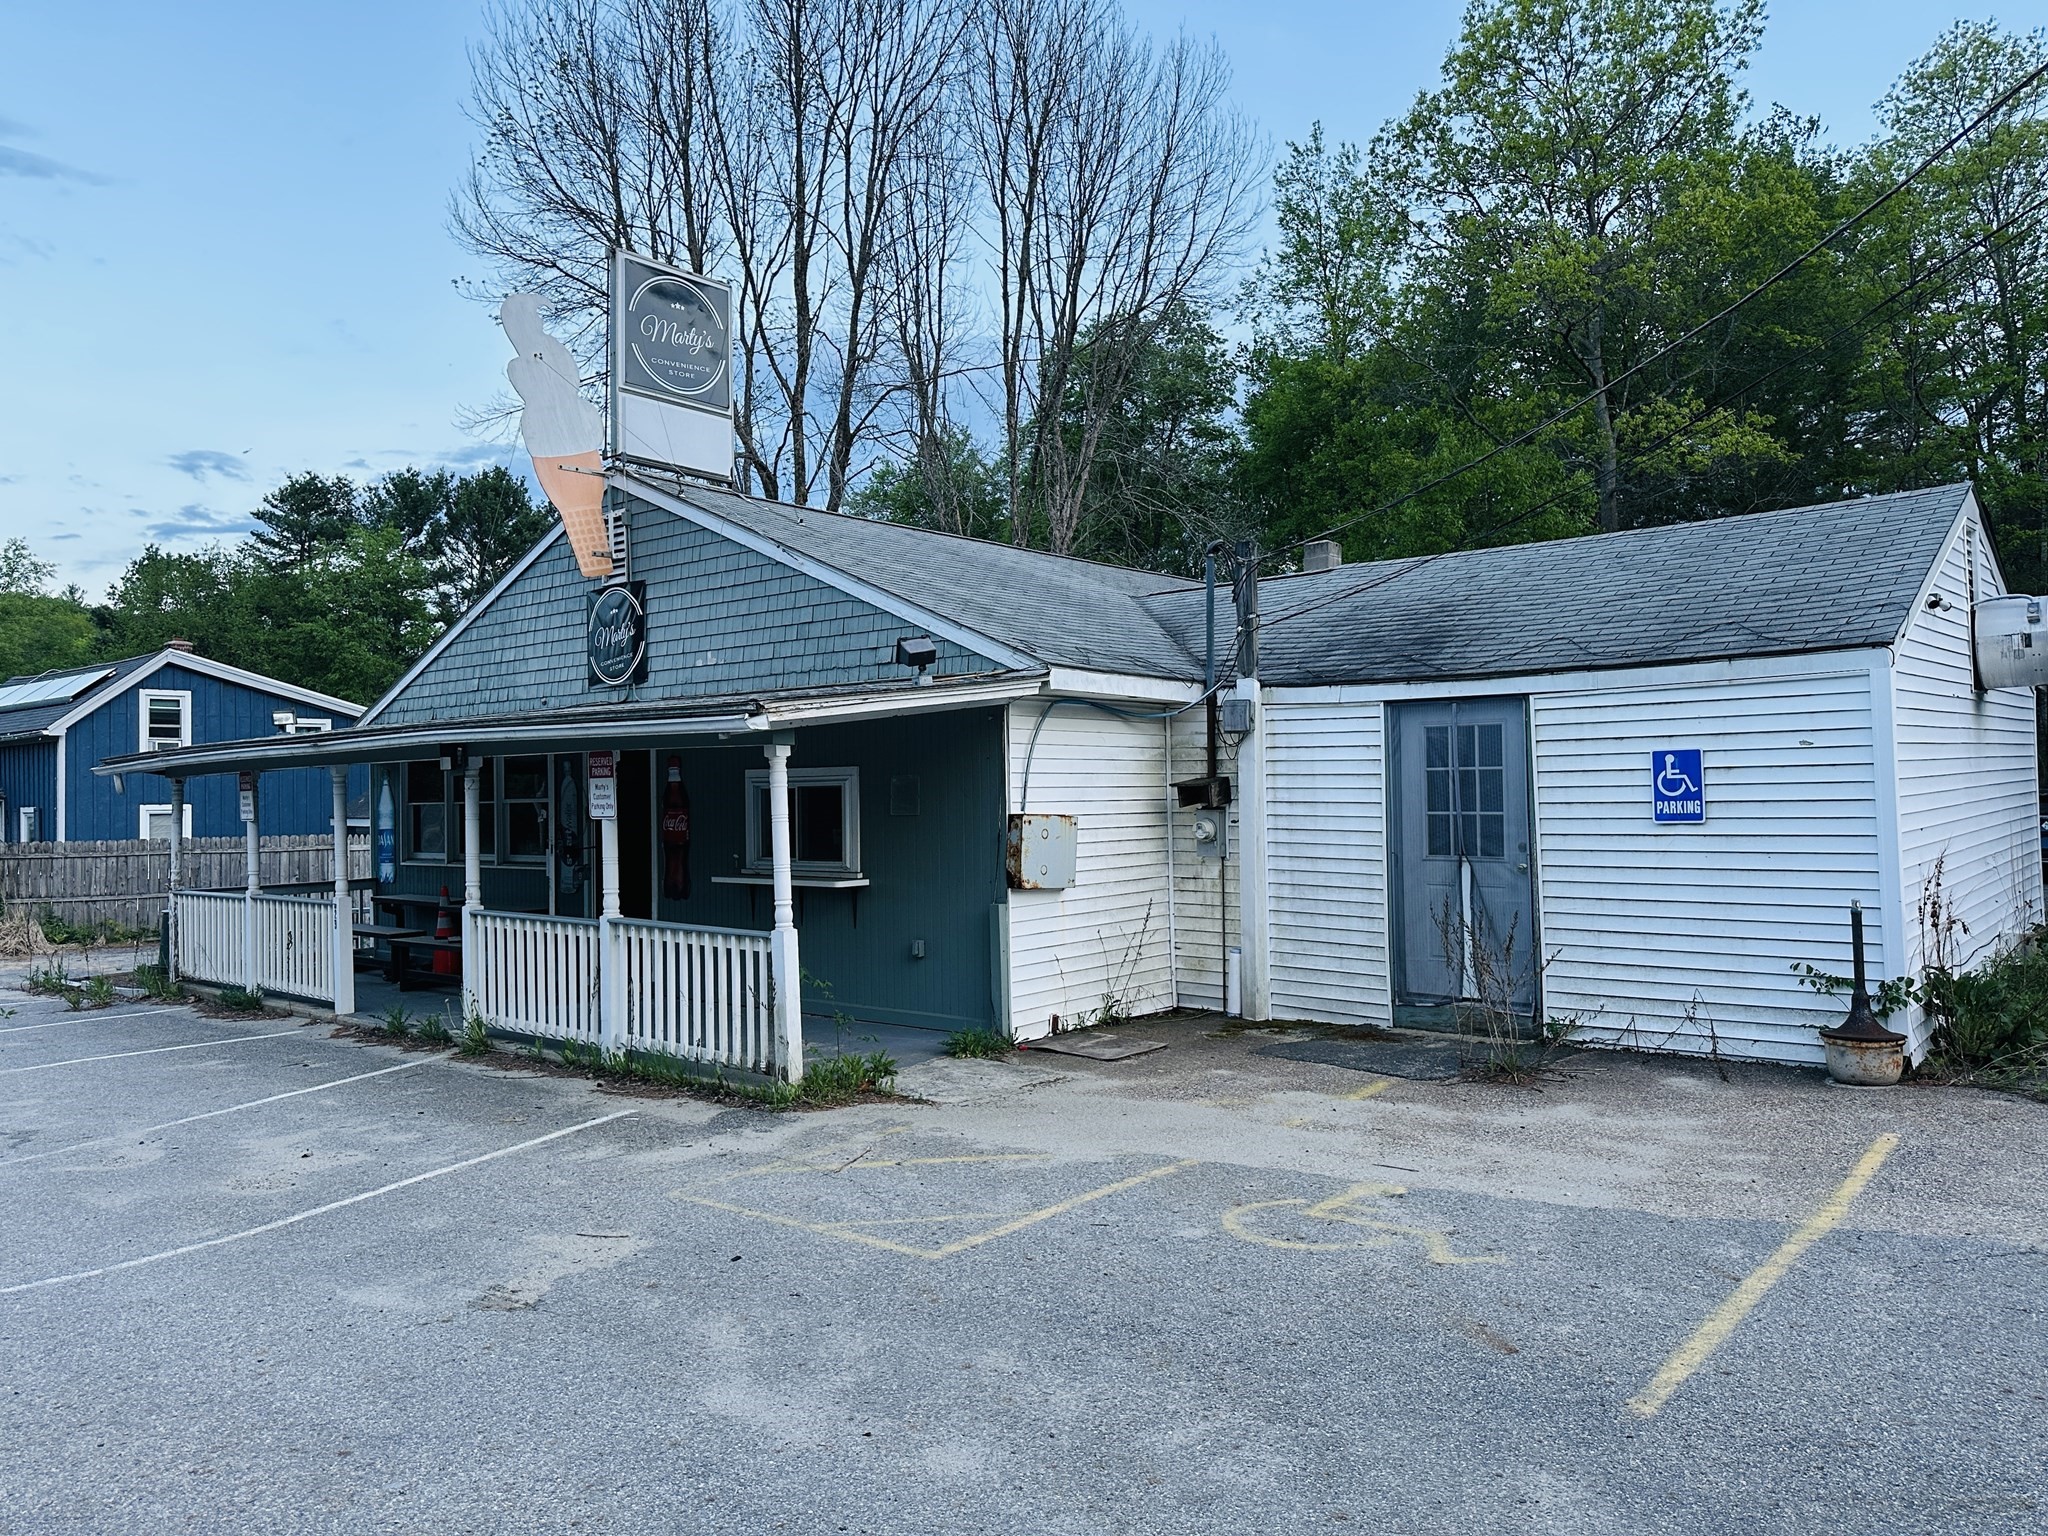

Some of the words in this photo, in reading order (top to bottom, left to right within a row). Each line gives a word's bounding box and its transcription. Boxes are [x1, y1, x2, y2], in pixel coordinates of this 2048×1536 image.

[640, 314, 714, 355] Marty's
[651, 357, 711, 373] CONVENIENCE
[668, 369, 696, 379] STORE
[594, 621, 636, 649] Marty's
[600, 652, 634, 667] CONVENIENCE
[609, 663, 625, 672] STORE
[589, 757, 613, 766] RESERVED
[591, 767, 611, 776] PARKING
[594, 783, 609, 792] Marty's
[591, 802, 605, 811] Parking
[1656, 800, 1701, 814] PARKING
